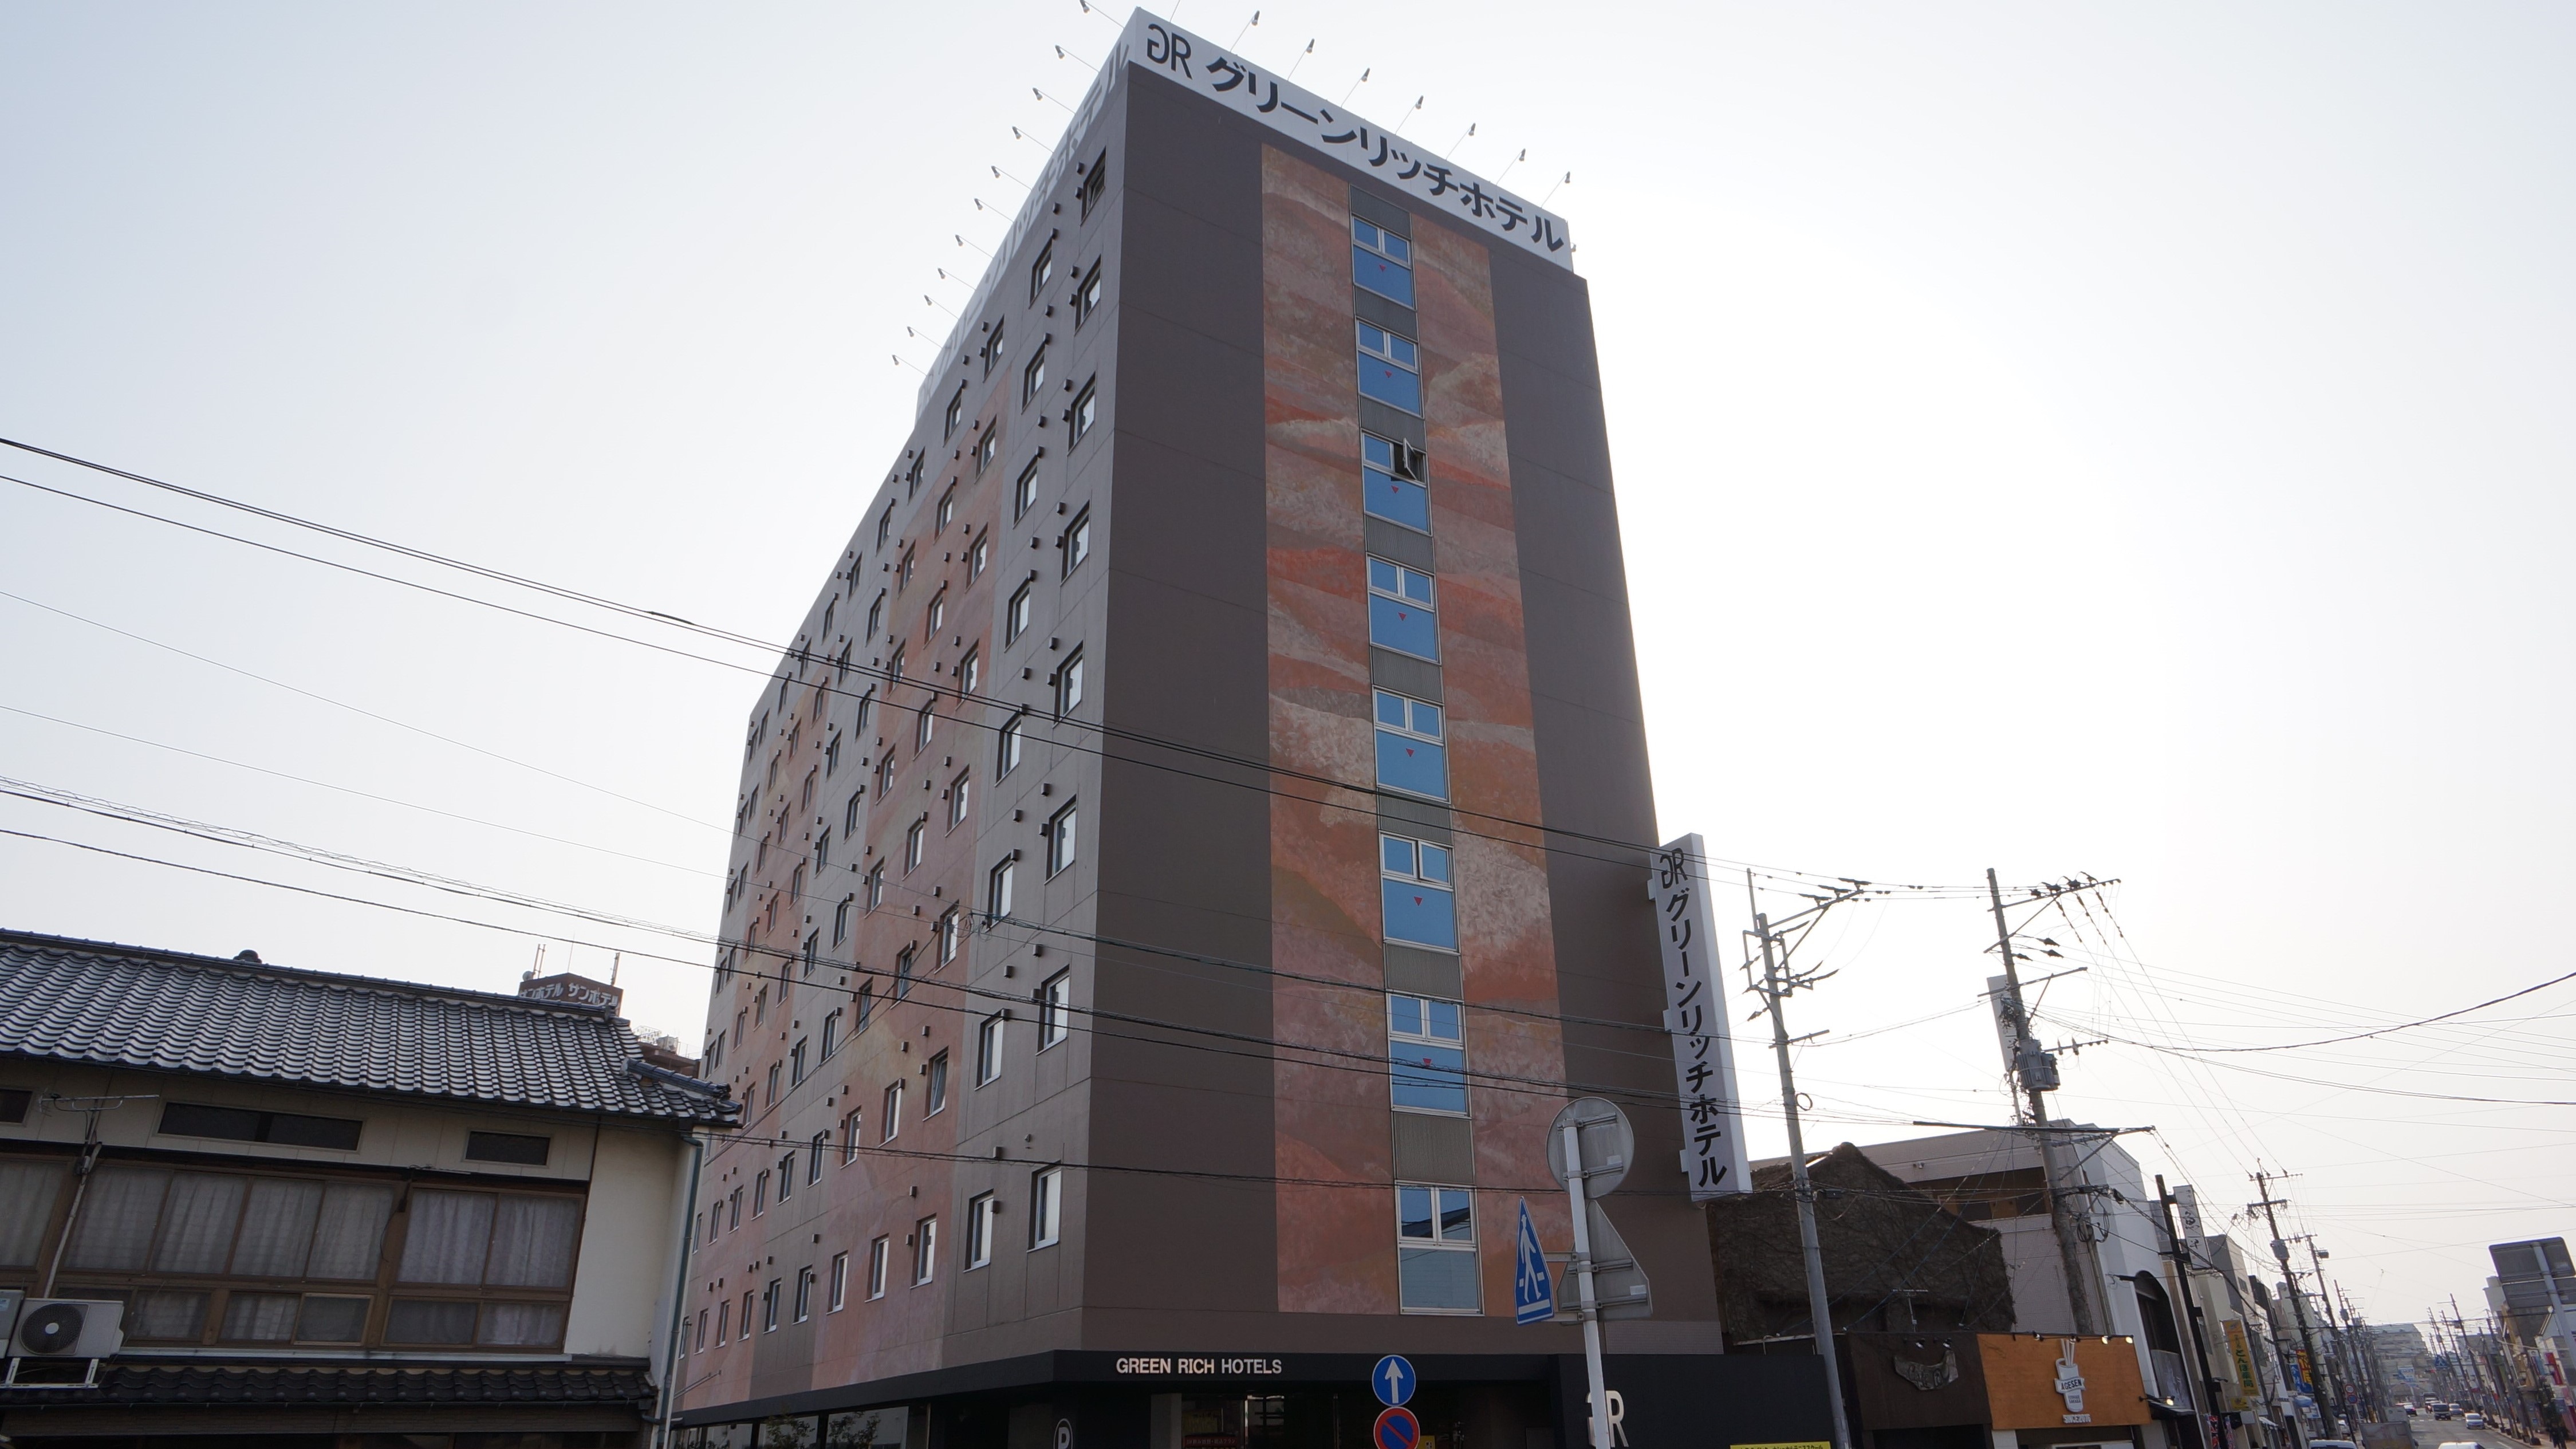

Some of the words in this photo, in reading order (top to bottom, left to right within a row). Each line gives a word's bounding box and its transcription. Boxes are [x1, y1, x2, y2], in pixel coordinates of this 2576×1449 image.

[1206, 56, 1565, 254] グリーンリッチホテル
[1666, 887, 1727, 1188] グリーンリッチホテル
[1116, 1358, 1171, 1374] GREEN
[1178, 1359, 1215, 1374] RICH
[1222, 1359, 1282, 1375] HOTELS
[2061, 1379, 2082, 1390] AGESEN
[1058, 1427, 1070, 1449] P
